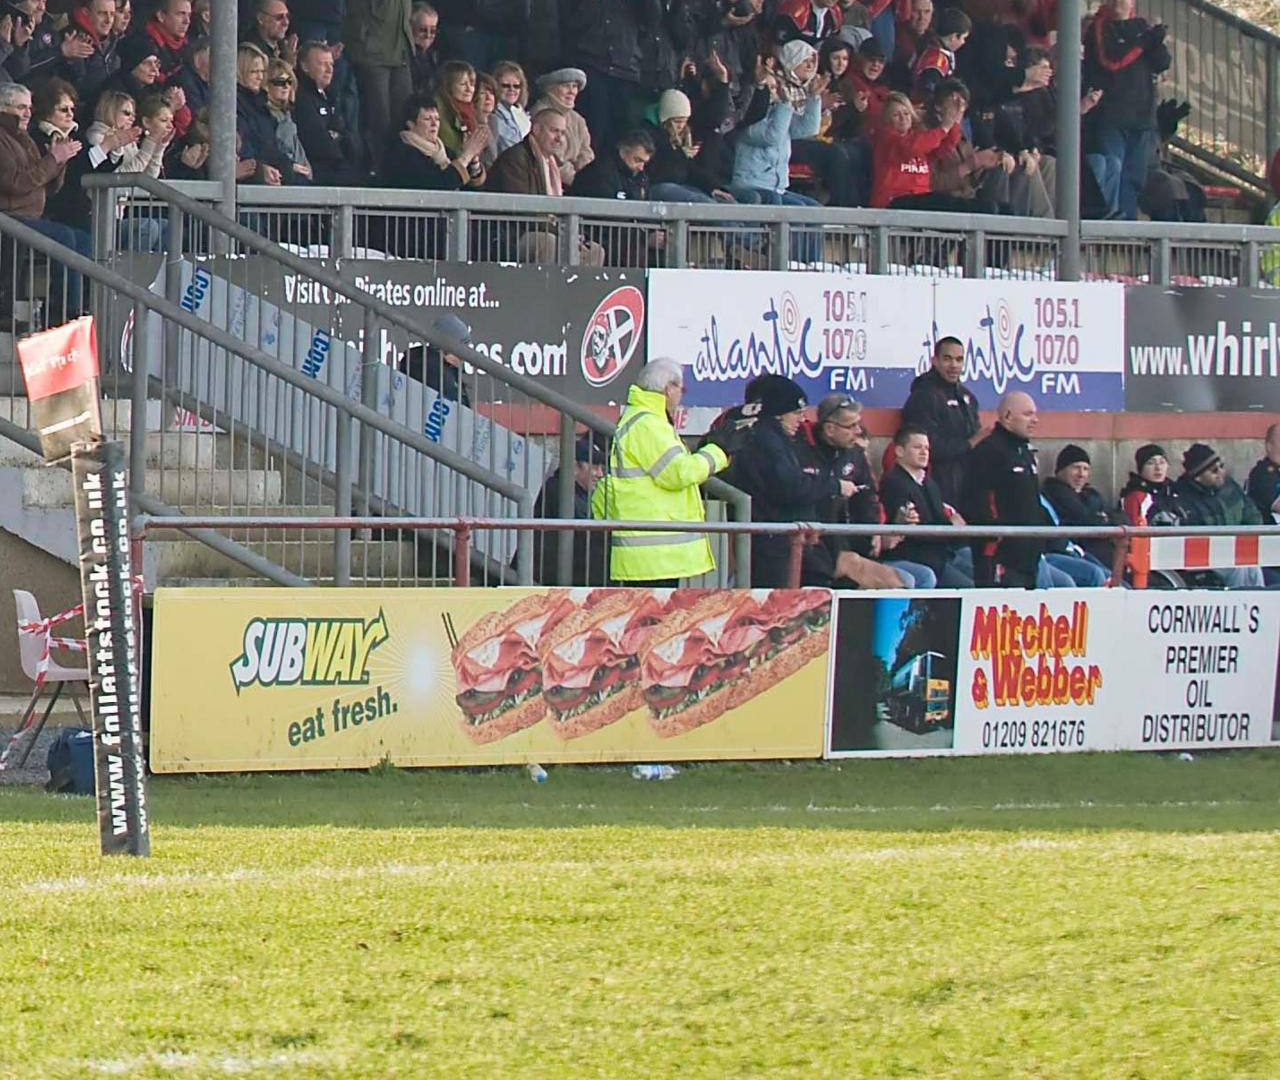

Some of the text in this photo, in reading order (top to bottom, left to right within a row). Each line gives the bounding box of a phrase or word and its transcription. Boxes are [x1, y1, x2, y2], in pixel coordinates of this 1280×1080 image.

[414, 277, 466, 308] online
[823, 290, 867, 322] 105.1
[1034, 297, 1080, 329] 105.1
[917, 299, 1034, 394] atlntic
[1130, 321, 1280, 377] www.whirl
[830, 373, 867, 391] FM
[1041, 373, 1081, 395] FM
[970, 601, 1088, 661] Mitchell
[229, 606, 389, 696] SUBWAY
[1165, 646, 1239, 674] PREMIER
[971, 653, 1103, 710] & Webber
[1186, 680, 1213, 708] OIL
[288, 686, 398, 747] eat fresh.
[1142, 713, 1251, 743] DISTRIBUTOR
[983, 720, 1085, 748] 01209 821676
